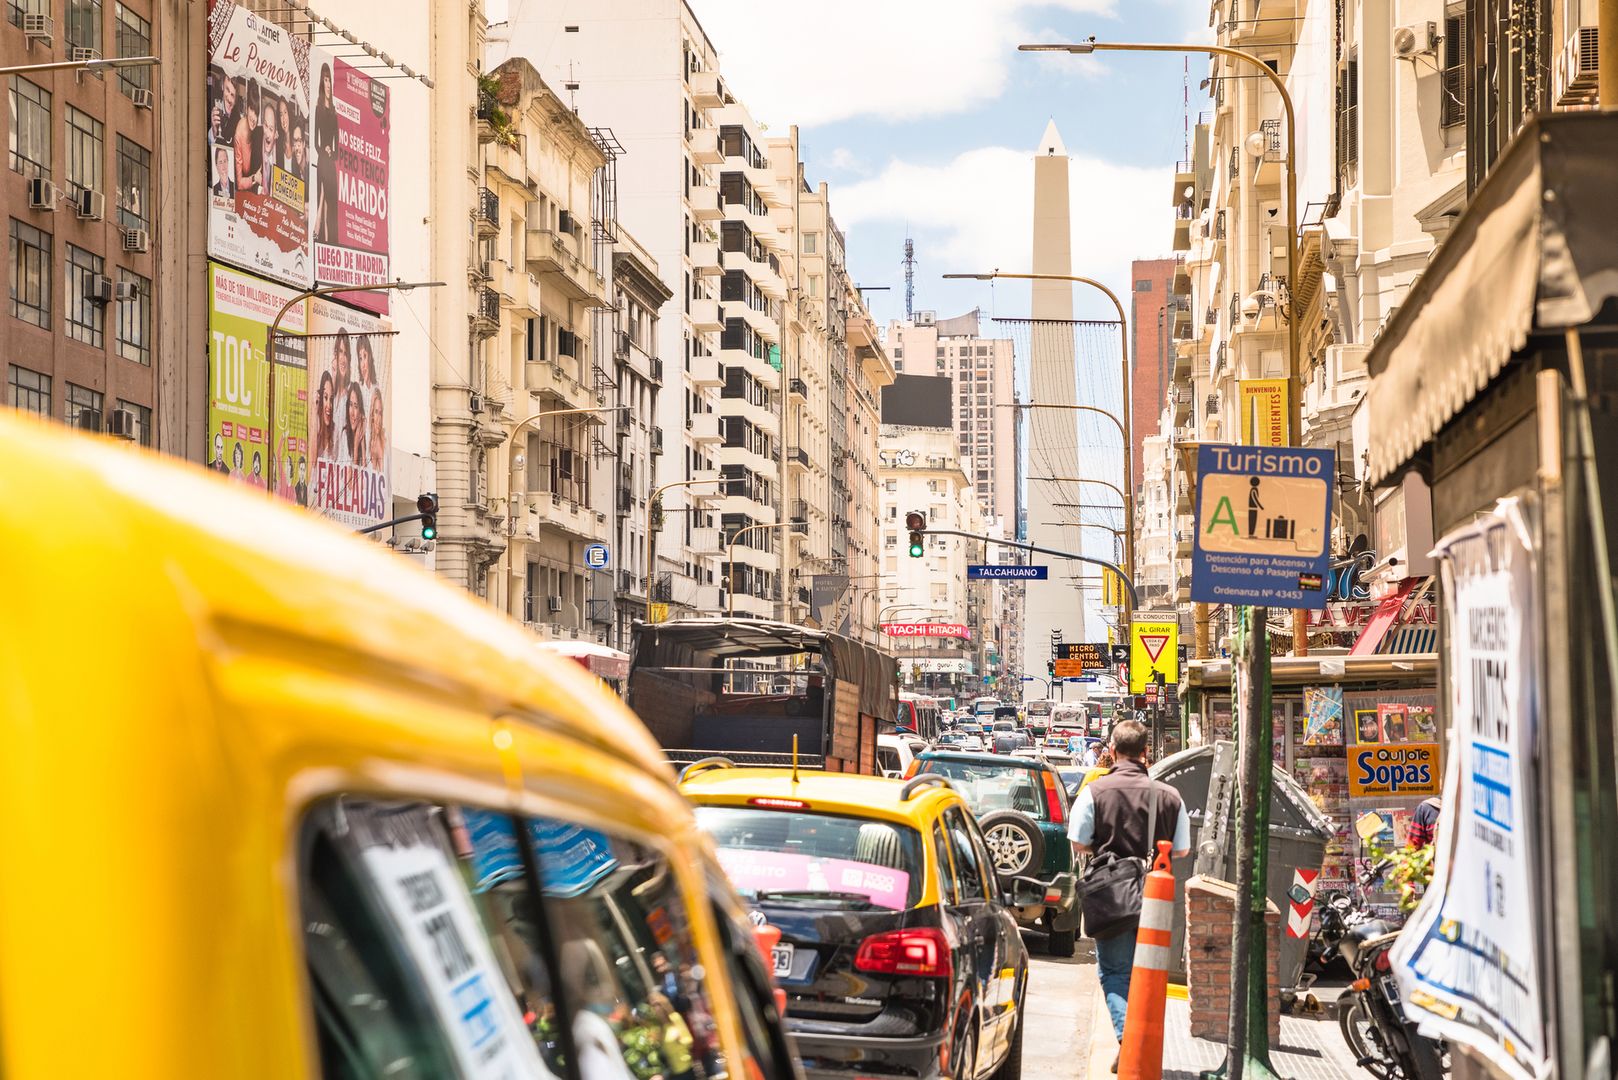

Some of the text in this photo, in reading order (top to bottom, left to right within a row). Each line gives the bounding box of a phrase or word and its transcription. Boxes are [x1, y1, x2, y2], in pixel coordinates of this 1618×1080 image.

[262, 24, 280, 44] Arnet
[223, 32, 241, 63] Le
[339, 129, 349, 147] NO
[350, 133, 364, 155] SERÉ
[339, 148, 385, 186] PERO TENGO
[280, 171, 299, 190] MEJOR
[338, 170, 387, 220] MARIDO
[317, 246, 341, 268] LUEGO
[344, 251, 354, 270] DE
[318, 266, 353, 285] NUEVAMENTE
[354, 272, 361, 285] EN
[215, 274, 228, 291] MÁS
[229, 280, 236, 294] DE
[246, 286, 271, 306] MILLONES
[272, 294, 279, 308] DE
[212, 330, 252, 406] TOC
[1211, 448, 1321, 475] Turismo
[317, 460, 386, 520] FALLADAS
[1206, 496, 1239, 536] A
[979, 568, 1038, 577] TALCAHUANO
[1206, 554, 1315, 570] Detención para Ascenso y
[1211, 565, 1251, 575] Descenso
[1253, 568, 1264, 576] de
[1213, 586, 1259, 597] Ordenanza
[1275, 590, 1303, 600] 43453
[1307, 607, 1336, 627] LA
[884, 624, 962, 635] HITACHI HITACHI
[1069, 652, 1099, 660] CENTRO
[1357, 750, 1432, 792] Sopas
[864, 872, 895, 884] TODO
